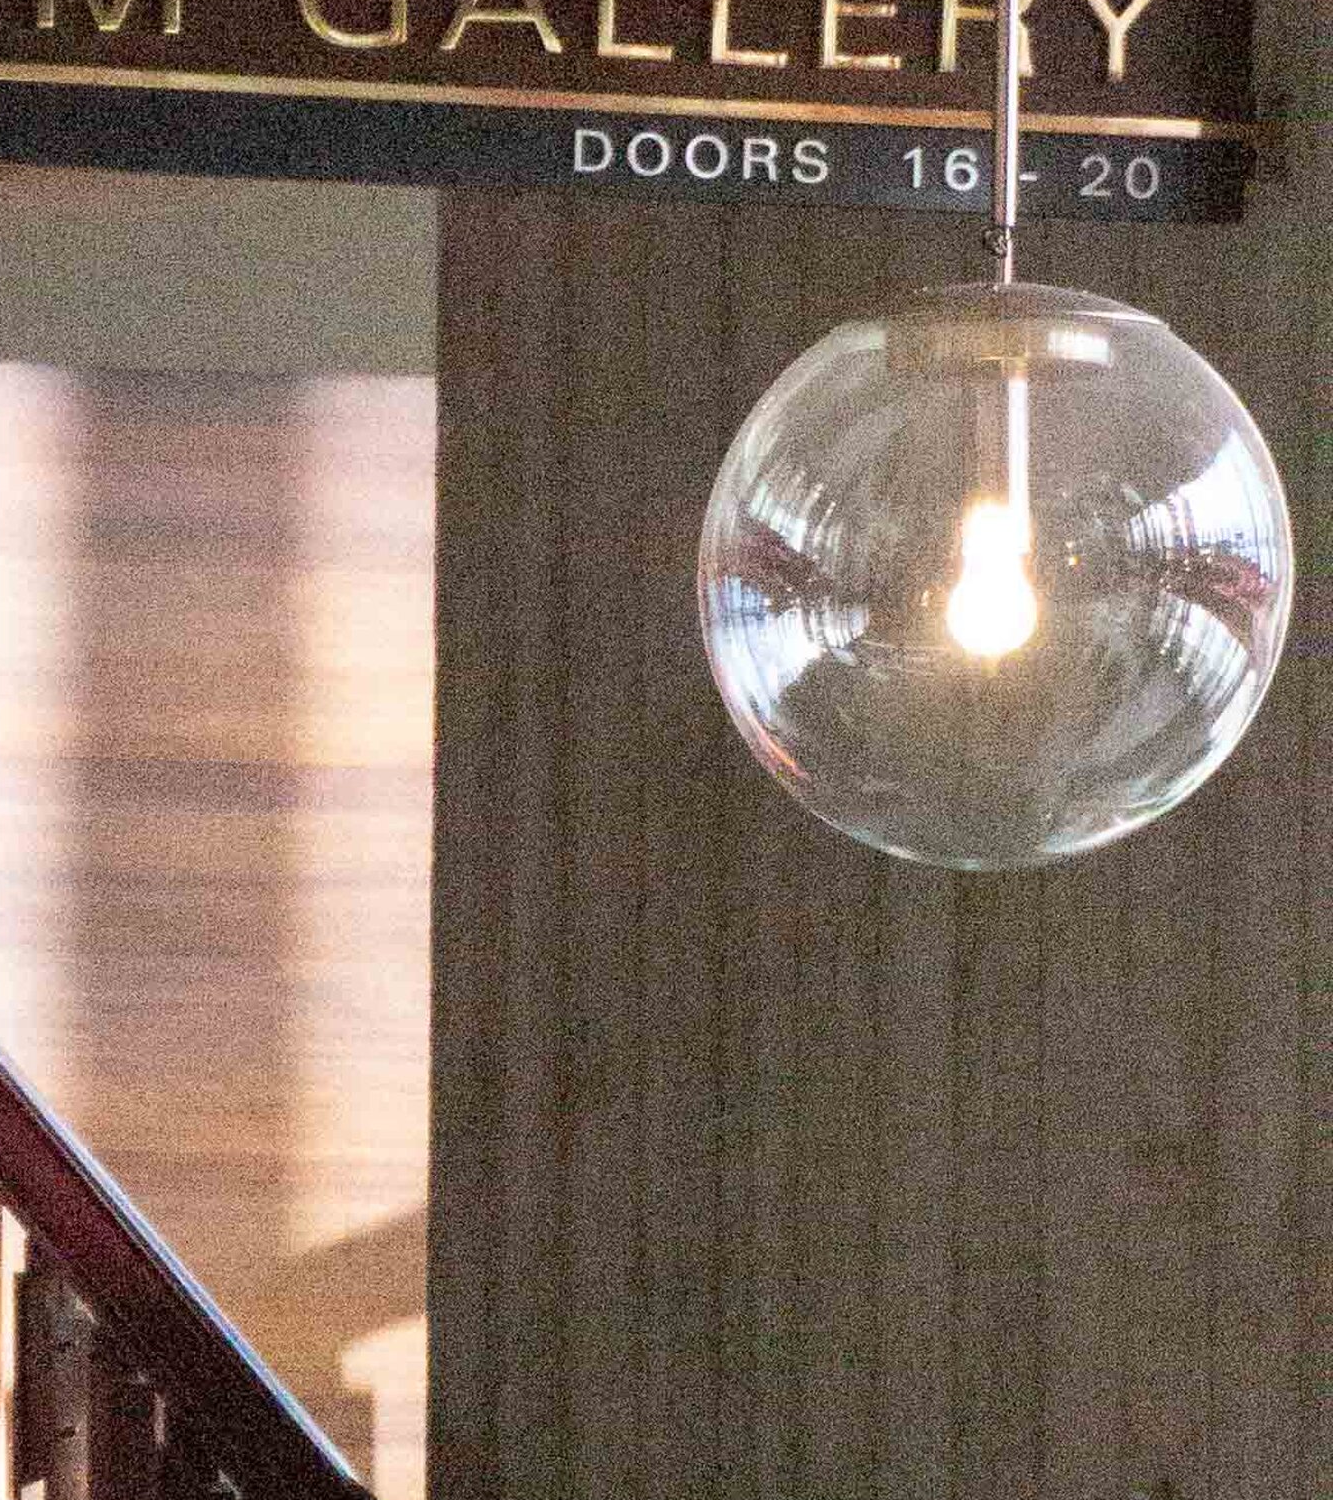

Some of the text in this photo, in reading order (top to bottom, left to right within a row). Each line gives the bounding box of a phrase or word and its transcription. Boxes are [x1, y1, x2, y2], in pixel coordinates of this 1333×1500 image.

[574, 128, 830, 184] DOORS
[902, 146, 979, 192] 16
[1079, 155, 1161, 200] 20
